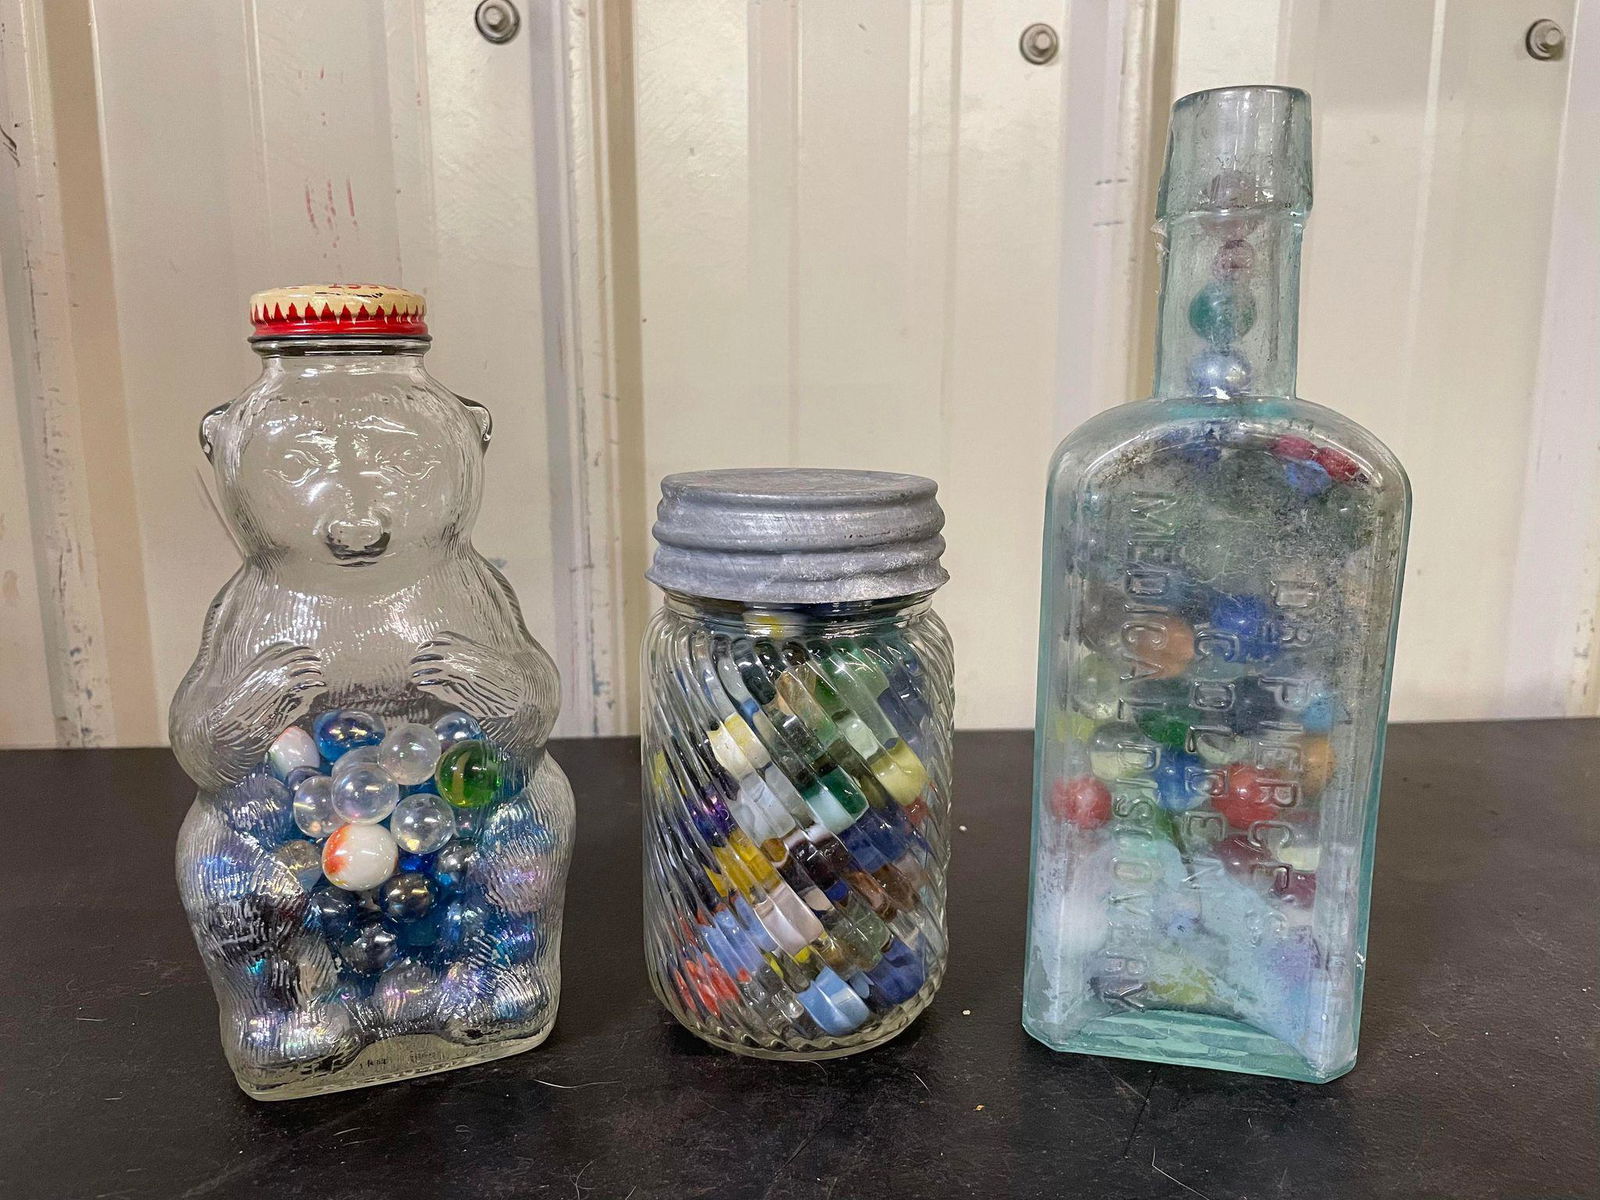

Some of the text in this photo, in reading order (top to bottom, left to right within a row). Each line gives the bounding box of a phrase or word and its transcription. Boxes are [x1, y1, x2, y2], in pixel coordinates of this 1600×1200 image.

[1102, 490, 1179, 1013] MEDICAL DISCOVERY
[1181, 627, 1240, 889] GOLDEN
